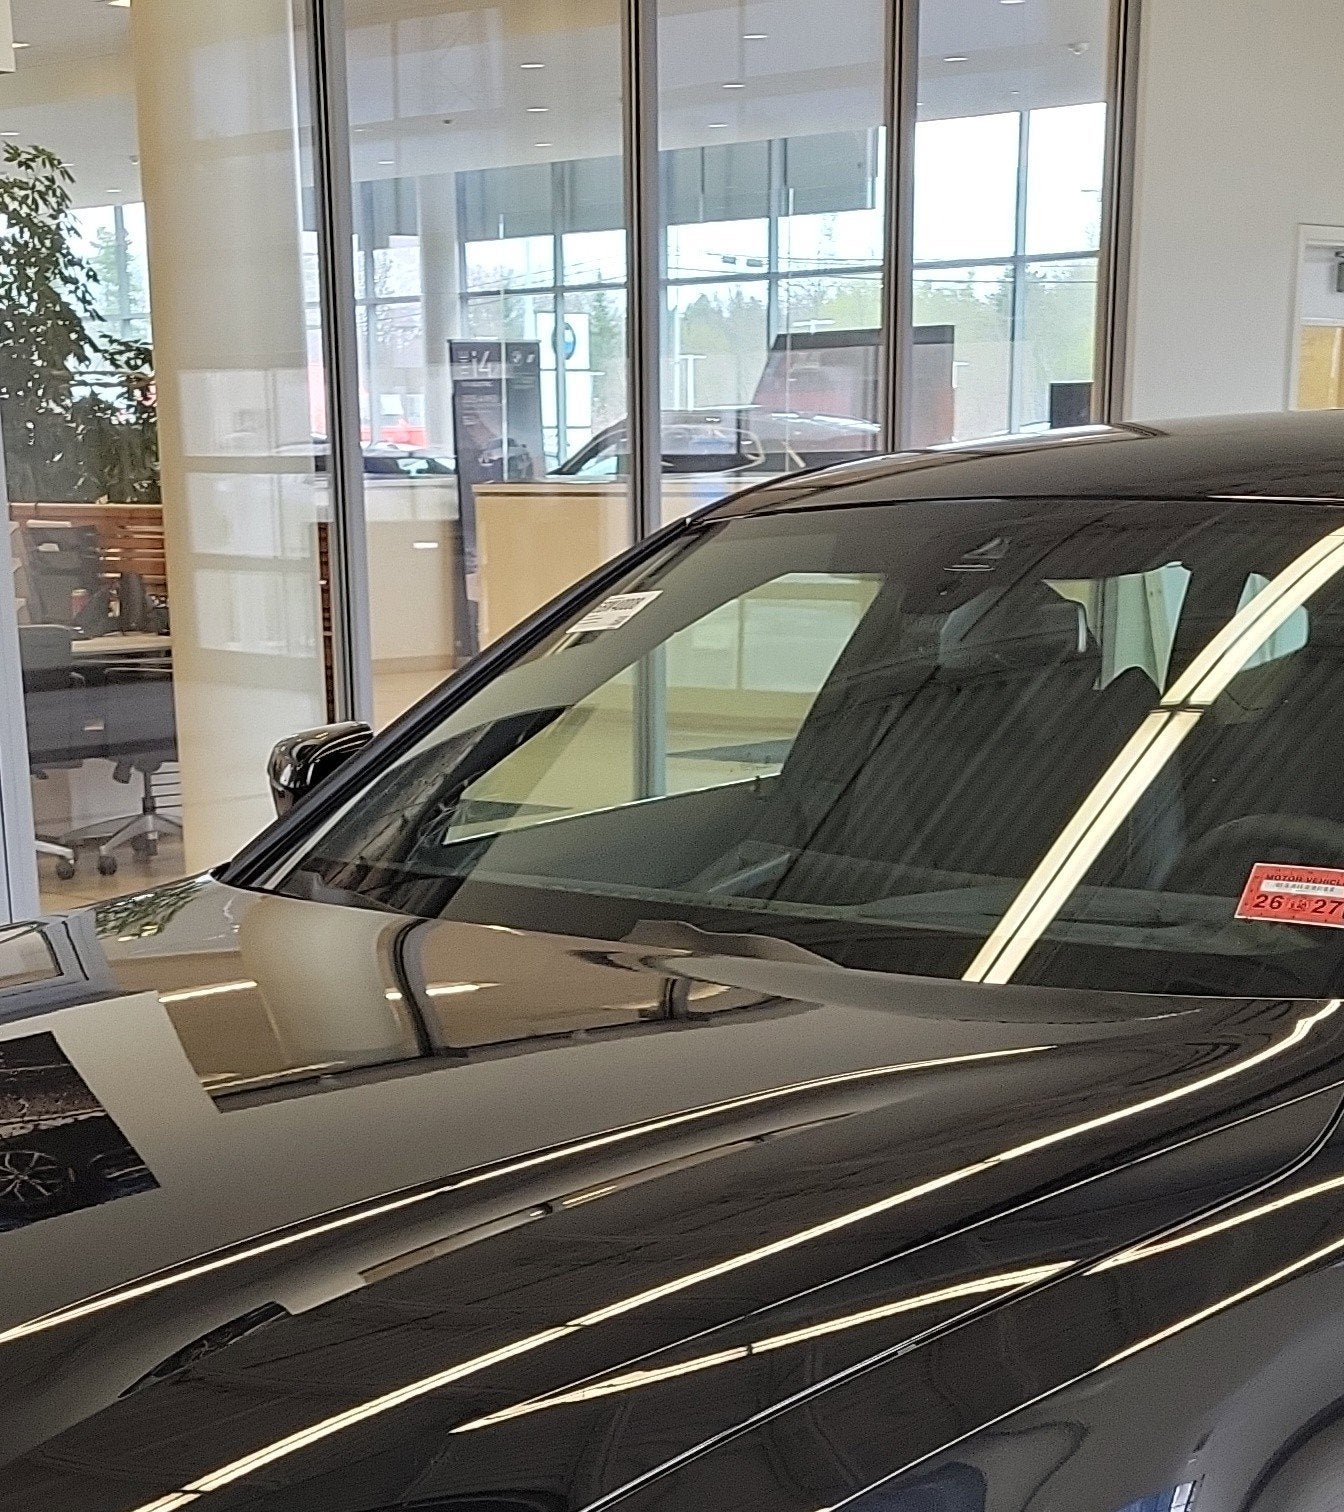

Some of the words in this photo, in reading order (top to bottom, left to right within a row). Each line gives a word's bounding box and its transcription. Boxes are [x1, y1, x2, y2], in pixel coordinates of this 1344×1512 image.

[1264, 874, 1303, 882] MOTOR
[1252, 893, 1285, 910] 26
[1310, 899, 1344, 915] 27
